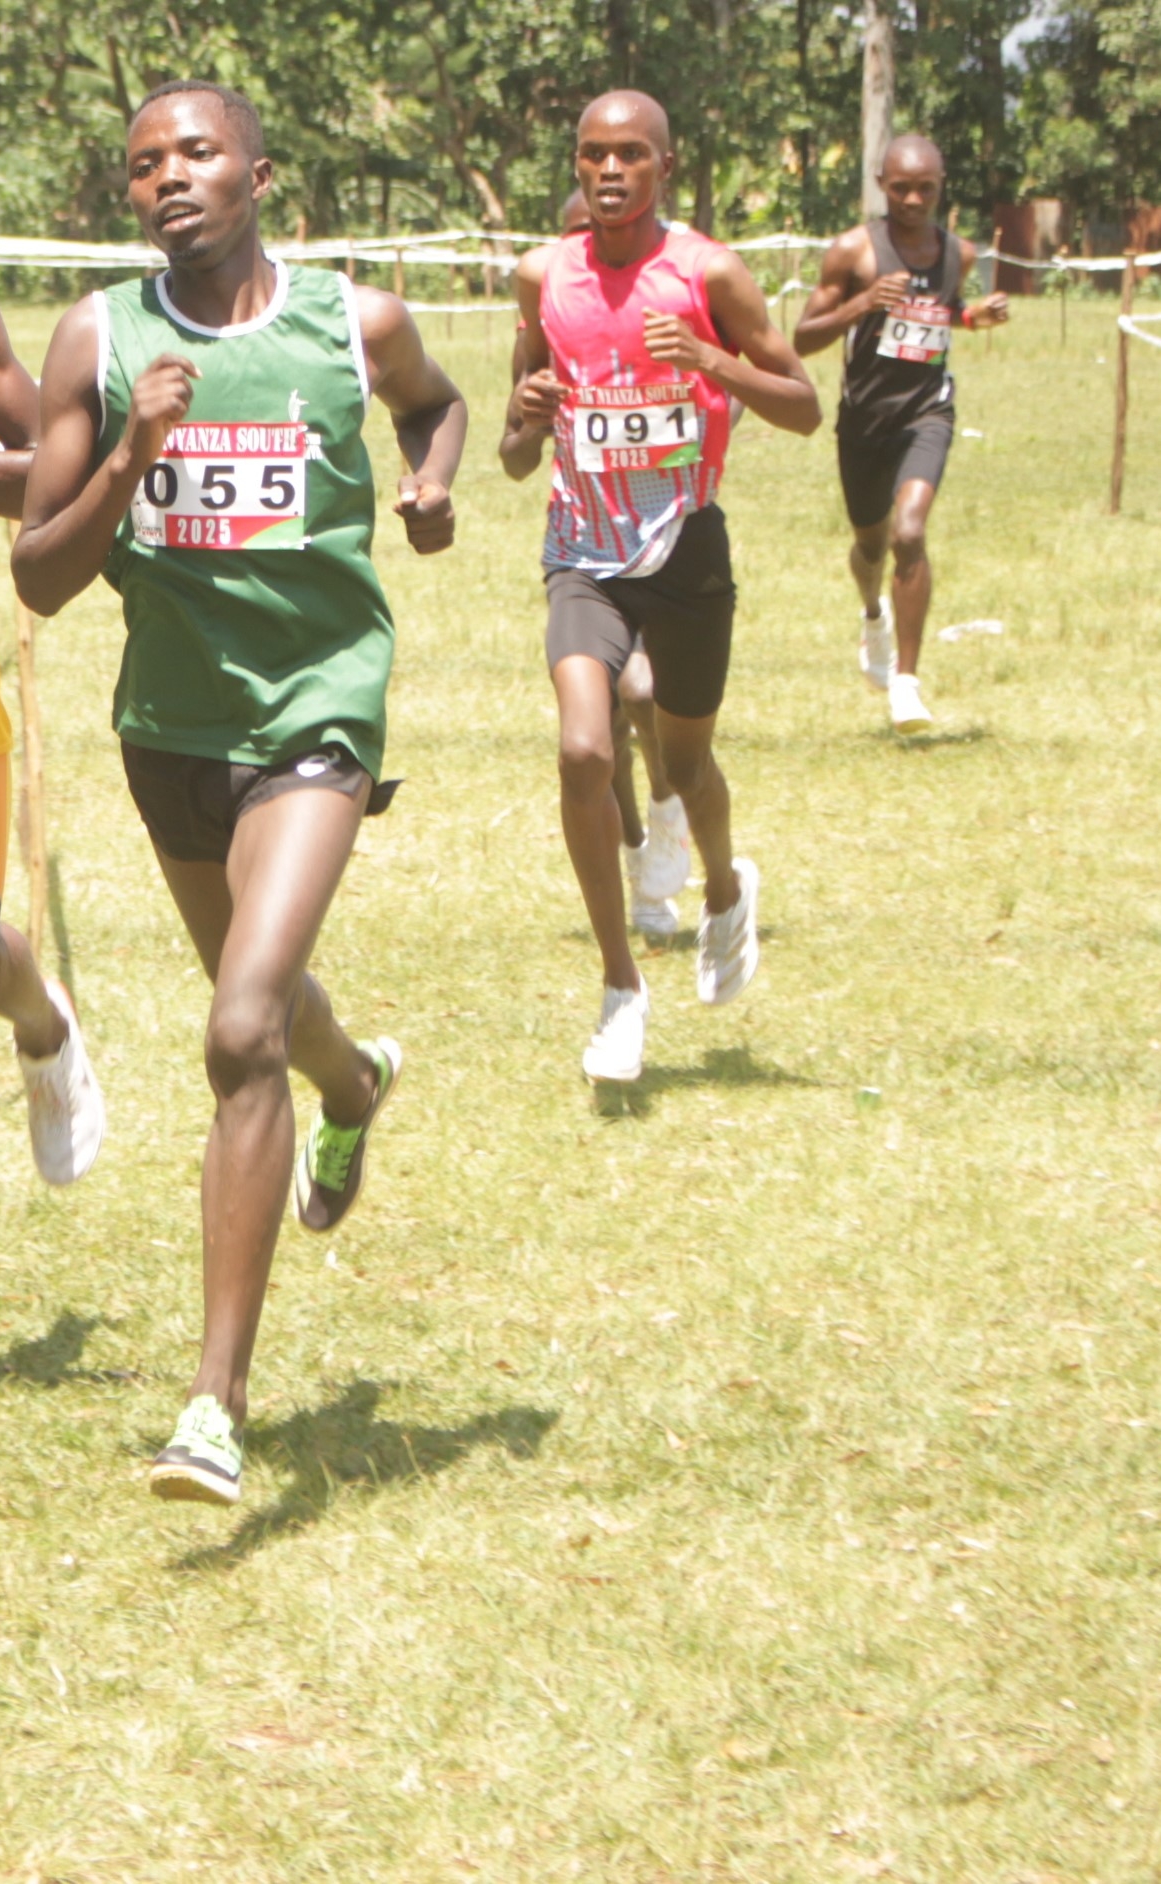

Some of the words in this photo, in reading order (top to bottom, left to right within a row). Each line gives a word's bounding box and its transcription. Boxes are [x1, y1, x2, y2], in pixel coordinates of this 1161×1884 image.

[587, 407, 685, 444] 091
[236, 426, 297, 452] SOUTH
[609, 449, 649, 468] 2025
[144, 463, 295, 510] 055
[177, 518, 231, 544] 2025
